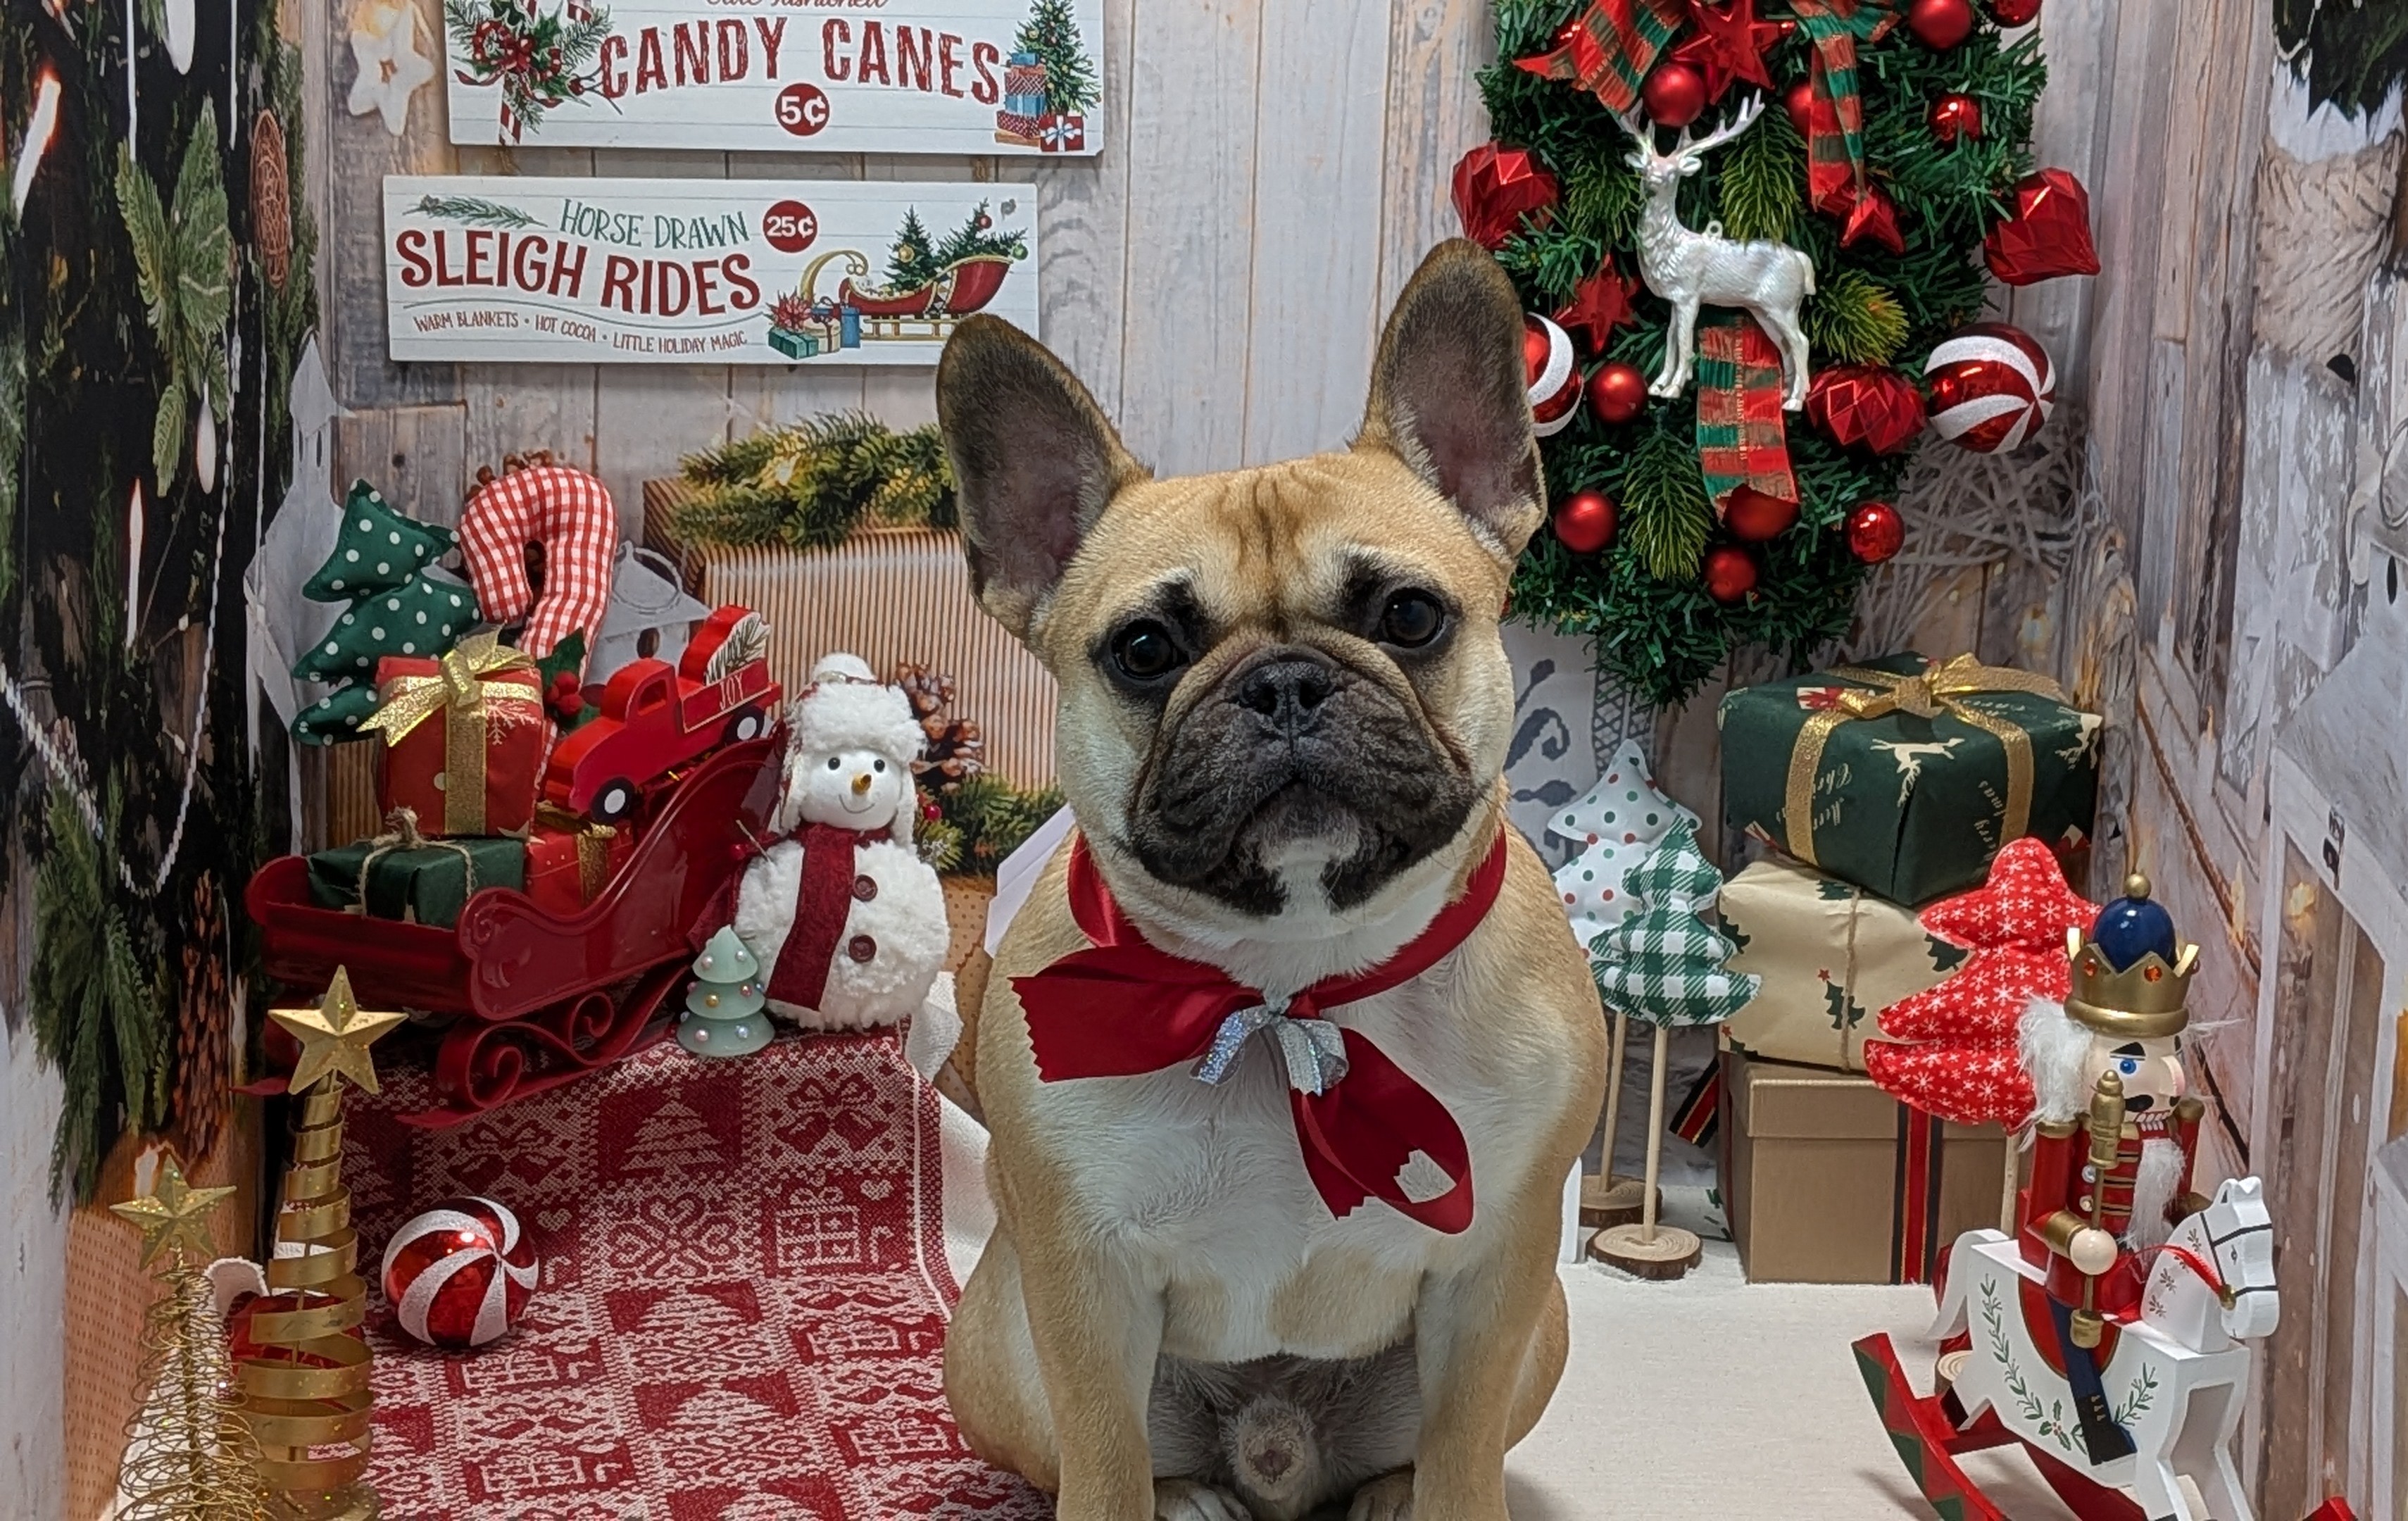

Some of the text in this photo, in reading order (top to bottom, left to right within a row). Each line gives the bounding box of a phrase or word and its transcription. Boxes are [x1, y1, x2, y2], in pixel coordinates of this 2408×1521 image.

[600, 17, 1000, 104] CANDY CANES
[779, 95, 826, 127] 5¢
[559, 198, 750, 249] HORSE DRAWN
[767, 215, 814, 239] 25¢
[396, 229, 761, 316] SLEIGH RIDES
[413, 311, 748, 353] WARM BLANKETS HOT COCOA LITTLE HOLIDAY MAGIC
[720, 672, 744, 711] JOY
[1812, 797, 1845, 831] Merr
